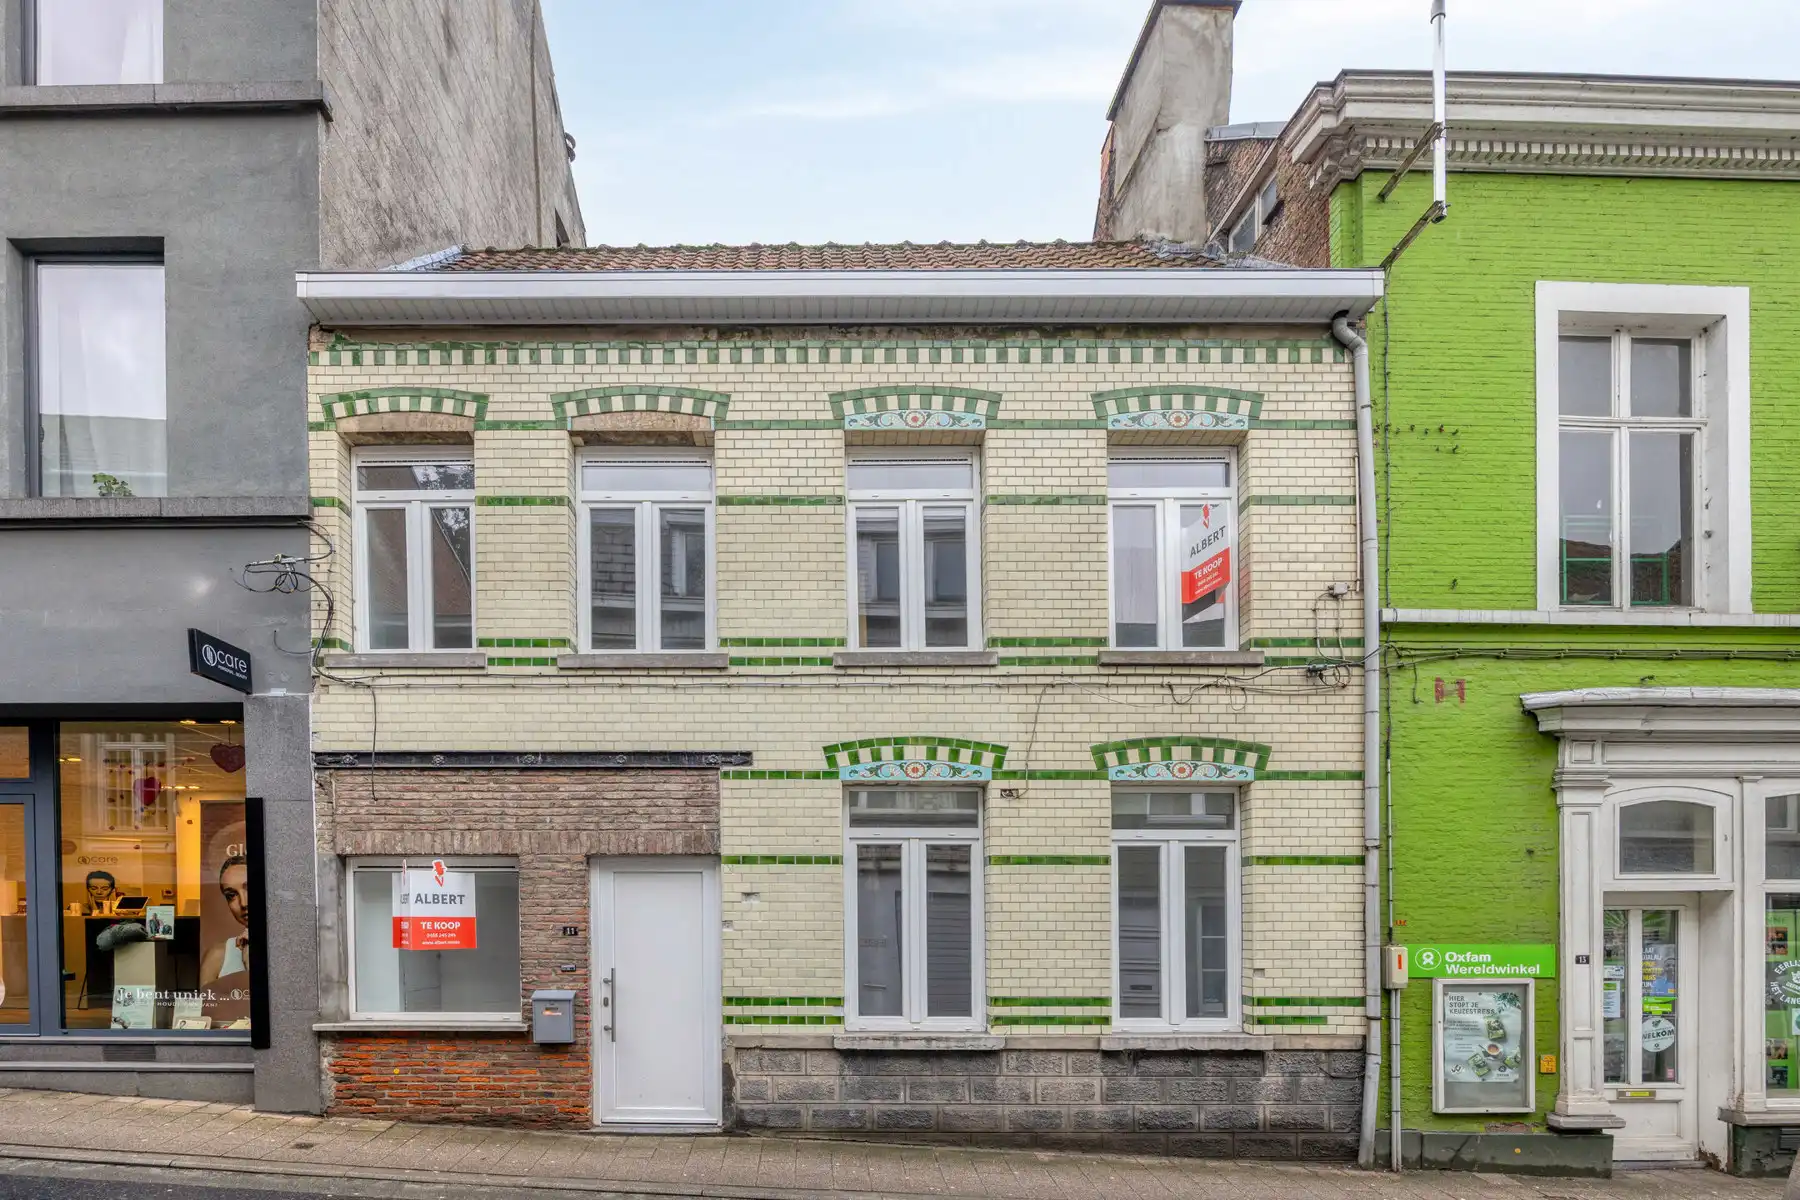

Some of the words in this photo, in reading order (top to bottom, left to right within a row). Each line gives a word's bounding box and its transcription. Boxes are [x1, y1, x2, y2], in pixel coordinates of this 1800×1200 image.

[1190, 525, 1226, 558] ALBERT
[1194, 569, 1203, 579] TE
[1202, 557, 1223, 575] KOOP
[217, 650, 247, 673] care
[91, 856, 119, 864] care
[414, 893, 466, 905] ALBERT
[420, 921, 433, 930] TE
[434, 921, 461, 930] KOOP
[1445, 951, 1492, 963] Oxfam
[1445, 964, 1540, 975] Wereldwinkel
[117, 988, 133, 1001] Je
[136, 988, 168, 1000] bent
[173, 989, 216, 1000] uniek
